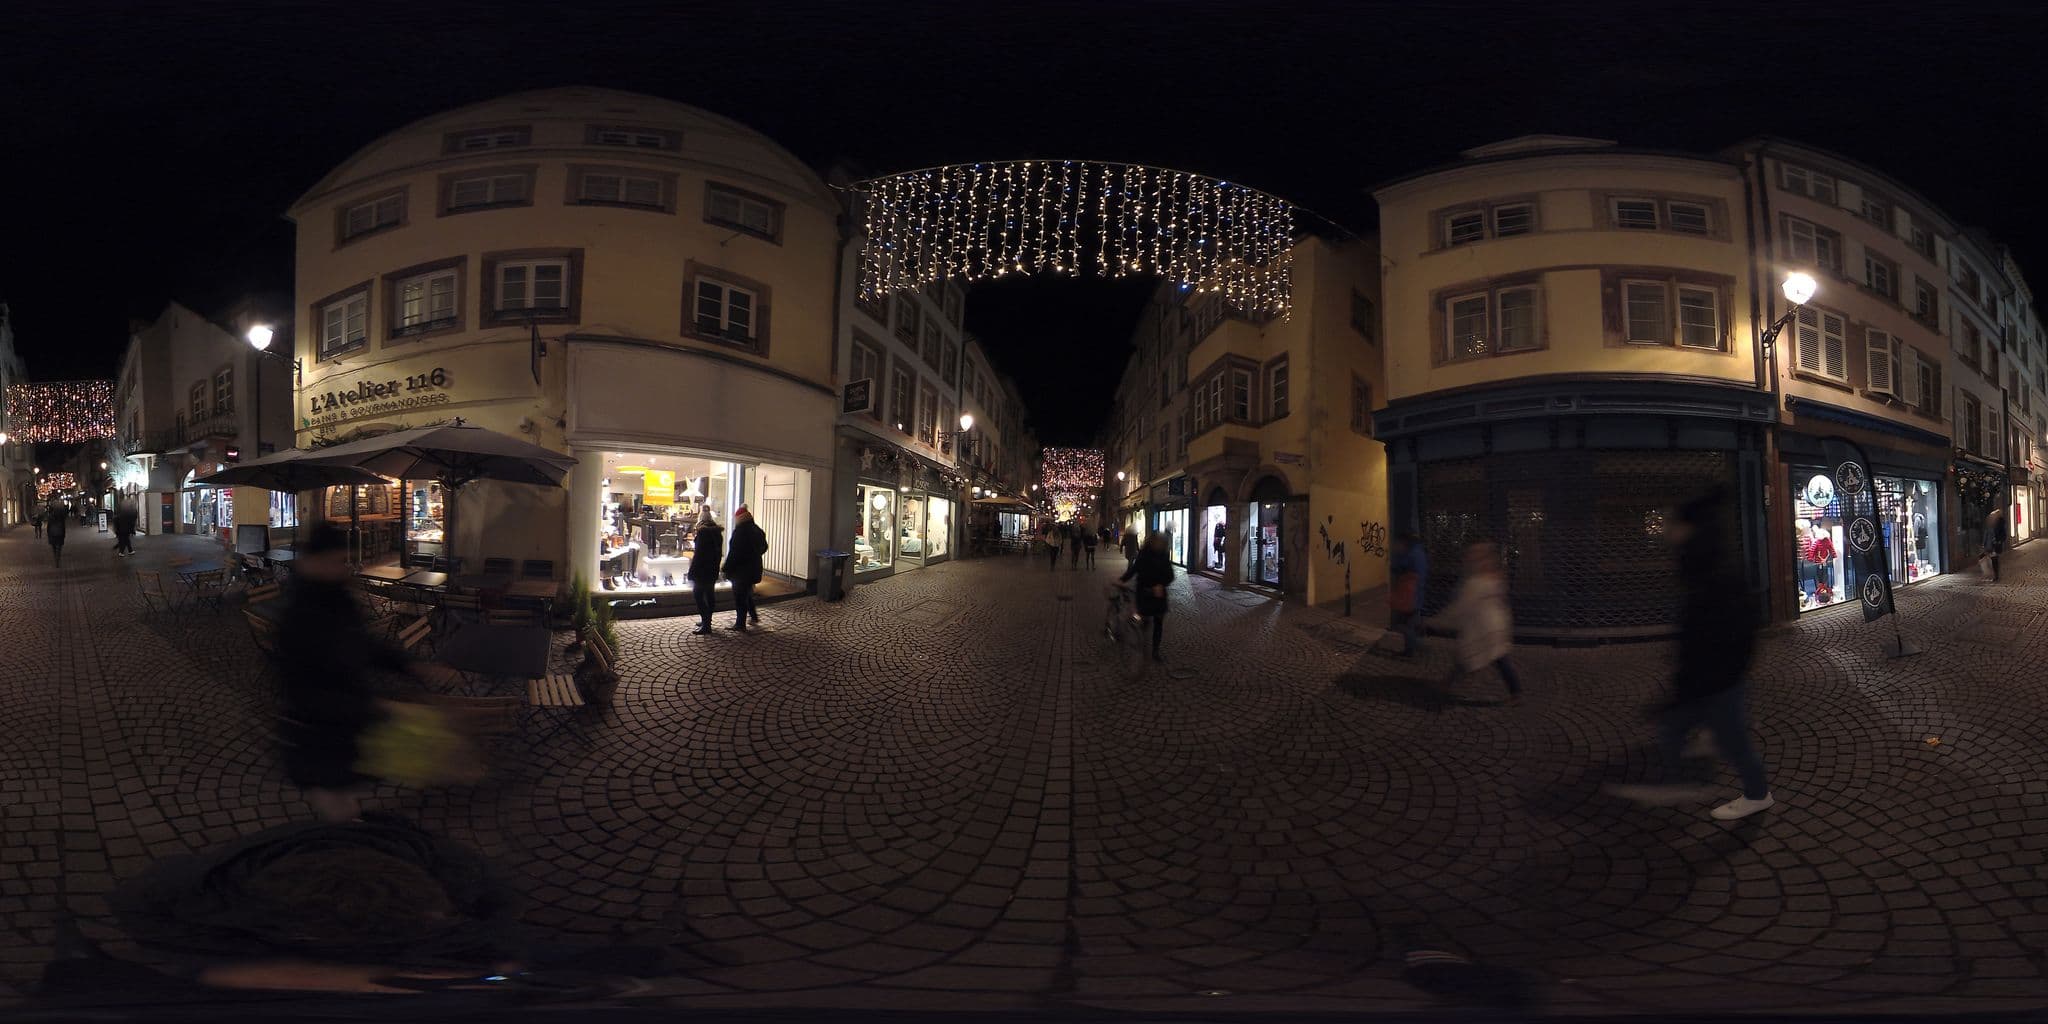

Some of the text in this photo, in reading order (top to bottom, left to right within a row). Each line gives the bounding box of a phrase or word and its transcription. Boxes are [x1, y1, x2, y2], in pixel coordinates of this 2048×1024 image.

[310, 367, 446, 413] L'Atelier 116
[311, 412, 336, 425] PAINS
[350, 393, 446, 417] GOURMANDISES
